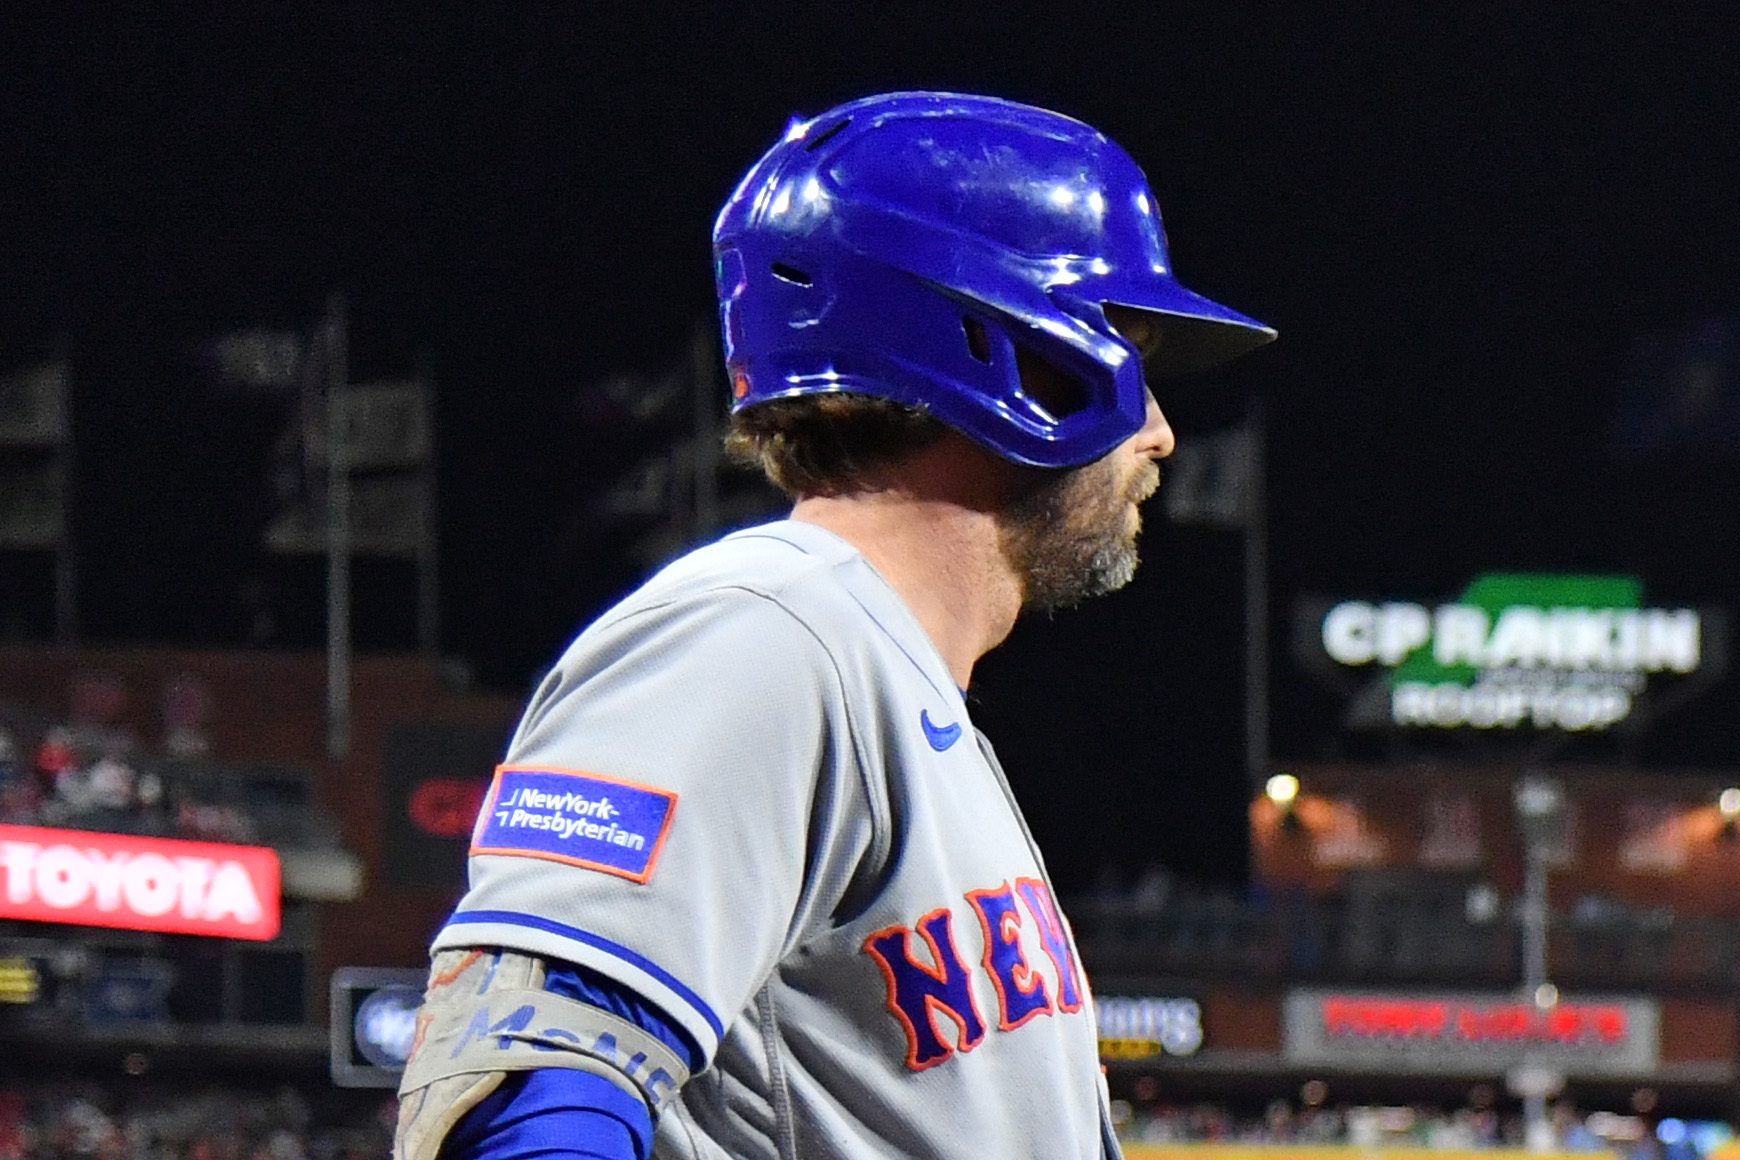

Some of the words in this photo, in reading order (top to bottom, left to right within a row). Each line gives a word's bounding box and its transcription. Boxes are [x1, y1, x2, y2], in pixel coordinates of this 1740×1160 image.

[1322, 601, 1433, 665] CP
[1393, 683, 1631, 730] ROOFTOP
[518, 788, 620, 820] NewYork-
[510, 809, 645, 851] Presbyterian
[0, 840, 264, 923] TOYOTA
